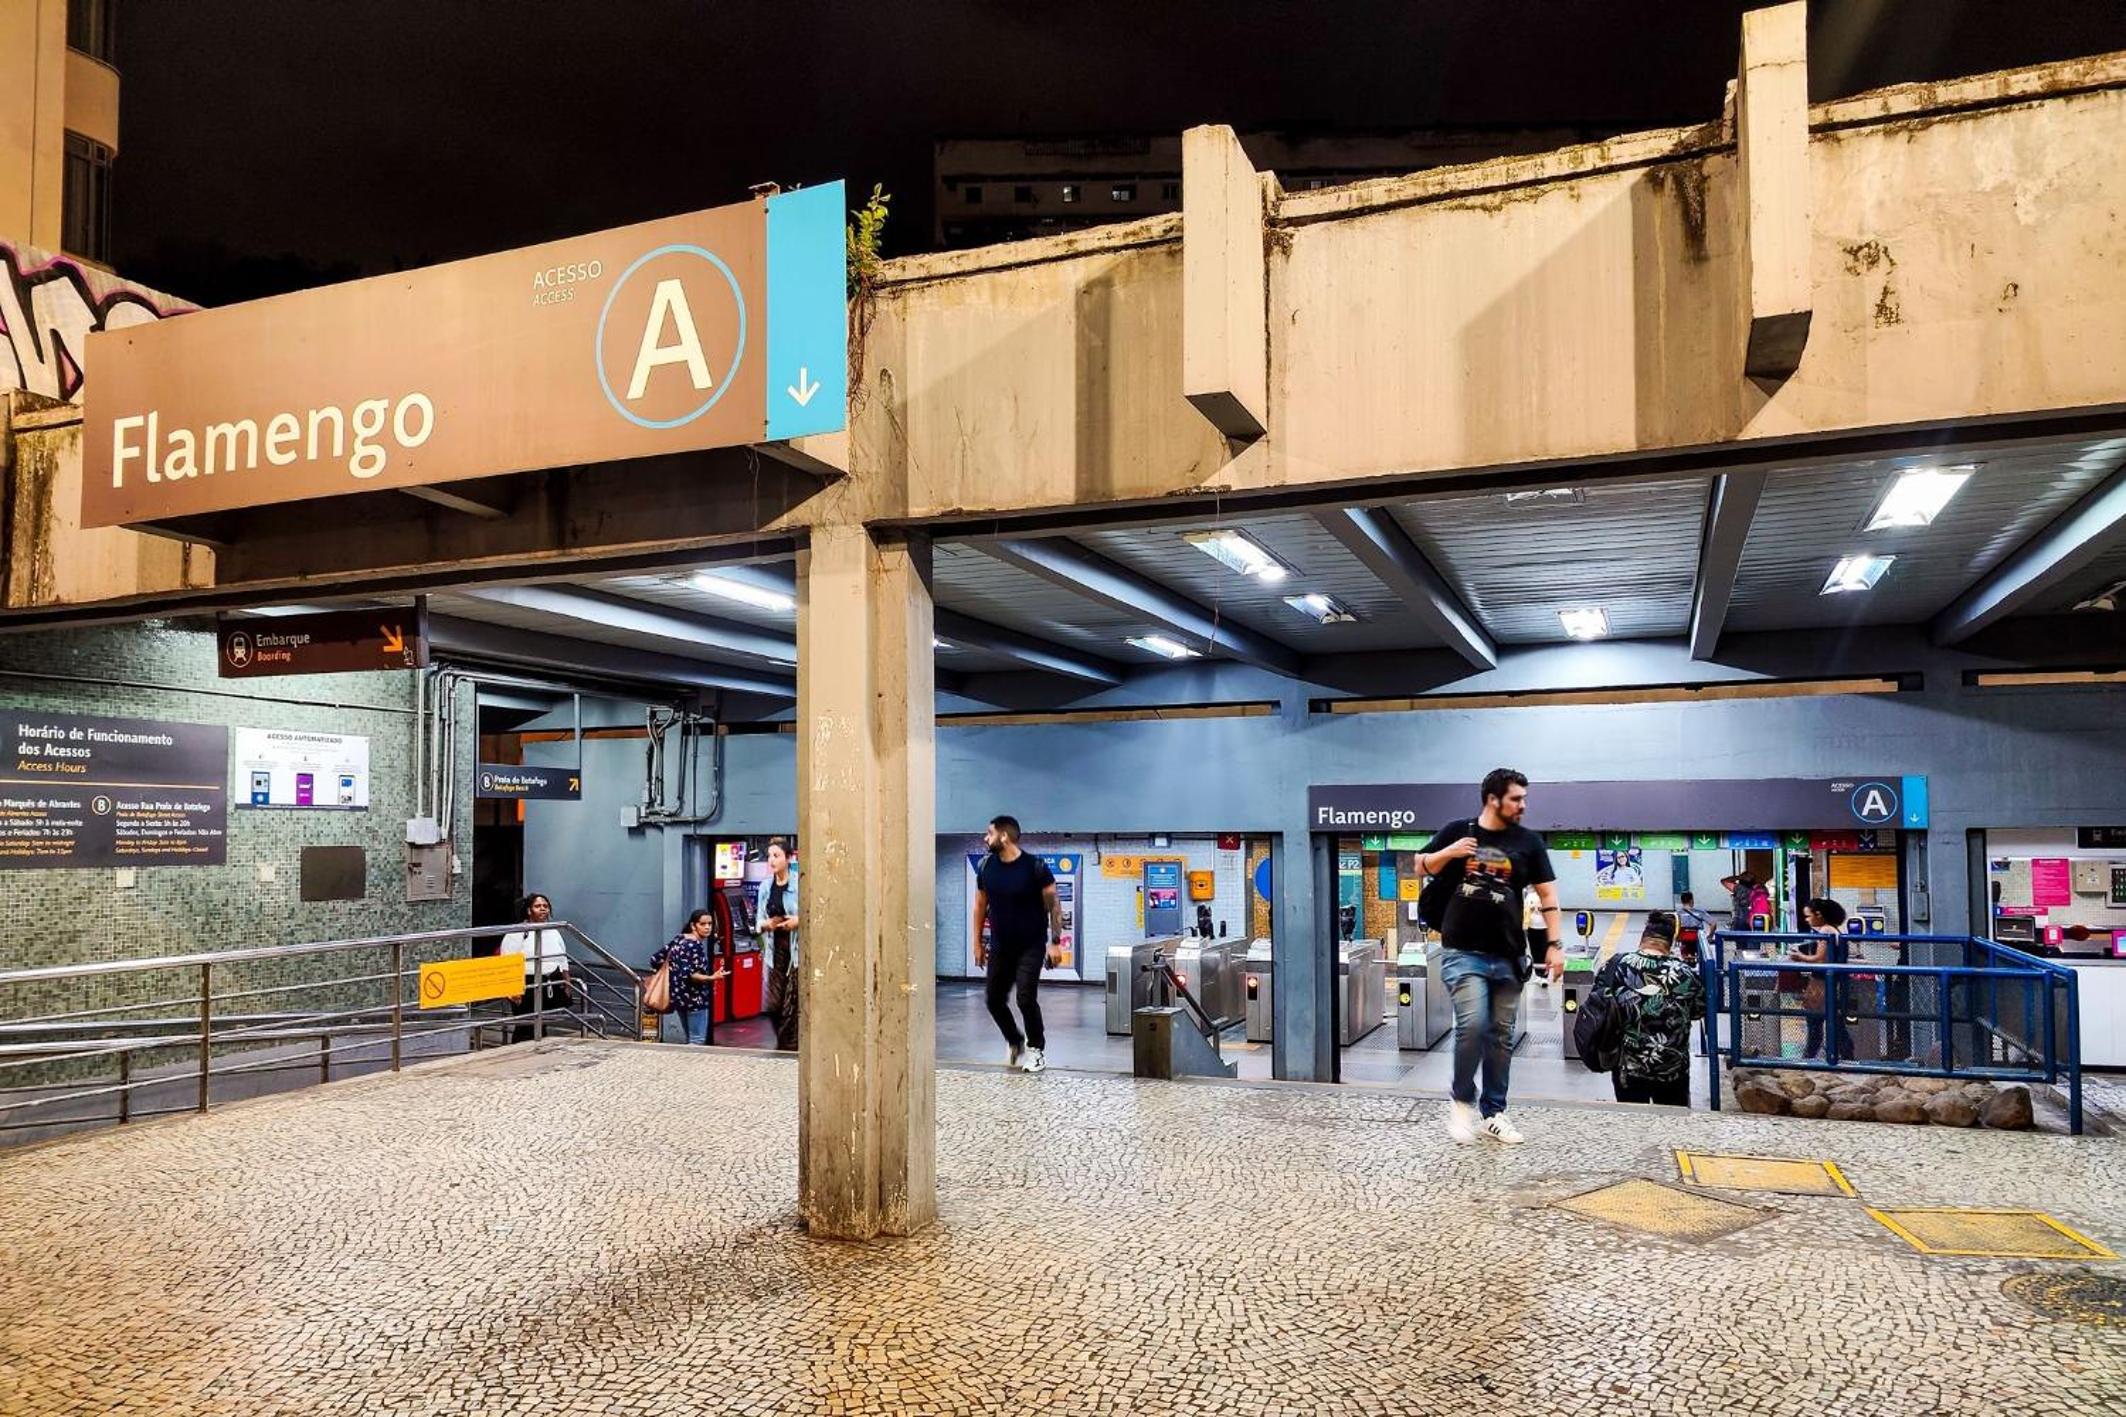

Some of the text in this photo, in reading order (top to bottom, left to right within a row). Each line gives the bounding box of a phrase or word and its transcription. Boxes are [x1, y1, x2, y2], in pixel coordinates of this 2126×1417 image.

[533, 260, 602, 289] ACESSO
[532, 287, 575, 307] ACCESS
[626, 278, 713, 400] A
[112, 392, 434, 488] Flamengo
[256, 633, 311, 648] Embarque
[257, 651, 291, 662] Boarding
[18, 723, 173, 746] Horário de Funcionamento
[18, 742, 91, 758] dos Acessos
[17, 760, 87, 773] Access Hours
[484, 776, 491, 788] B
[97, 799, 107, 811] B
[1861, 789, 1888, 816] A
[1318, 807, 1416, 829] Flamengo
